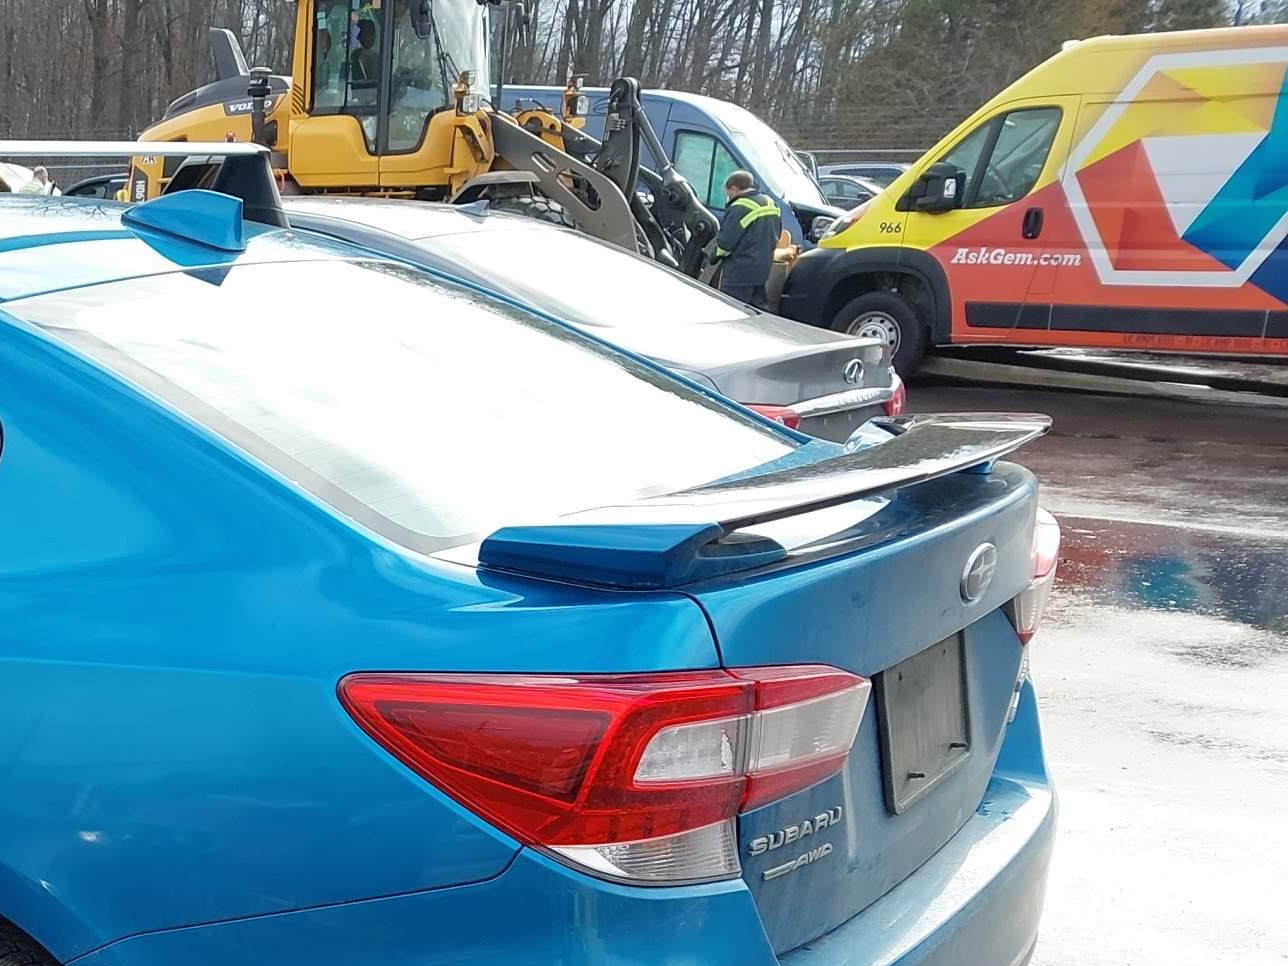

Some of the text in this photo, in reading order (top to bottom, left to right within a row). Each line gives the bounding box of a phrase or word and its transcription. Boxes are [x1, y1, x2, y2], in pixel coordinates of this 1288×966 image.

[228, 100, 272, 112] VOLO
[879, 222, 902, 234] 966
[950, 247, 1081, 266] AskGem.com
[749, 806, 843, 856] SUBARU
[792, 842, 833, 870] AWD
